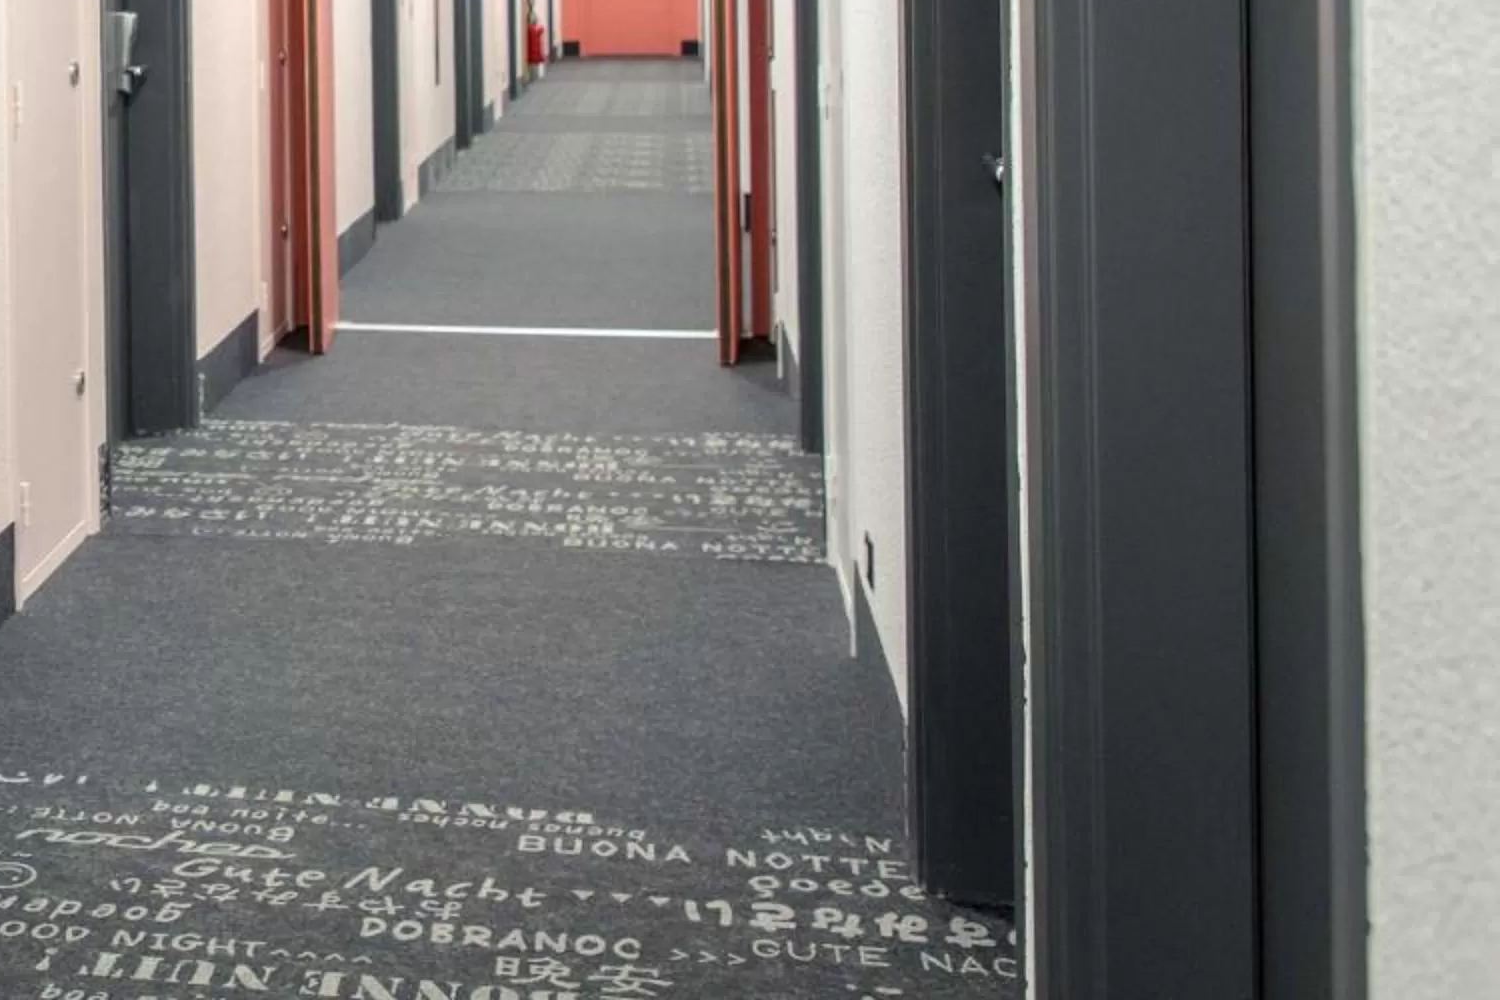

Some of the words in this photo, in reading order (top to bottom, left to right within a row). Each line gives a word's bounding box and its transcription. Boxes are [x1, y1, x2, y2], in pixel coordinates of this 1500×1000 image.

[516, 833, 692, 864] BUONA
[725, 846, 912, 882] NOTTE
[171, 857, 328, 889] Gute
[343, 865, 550, 910] Nacht
[110, 928, 268, 958] NIGHT
[359, 917, 643, 961] DOBRANOC
